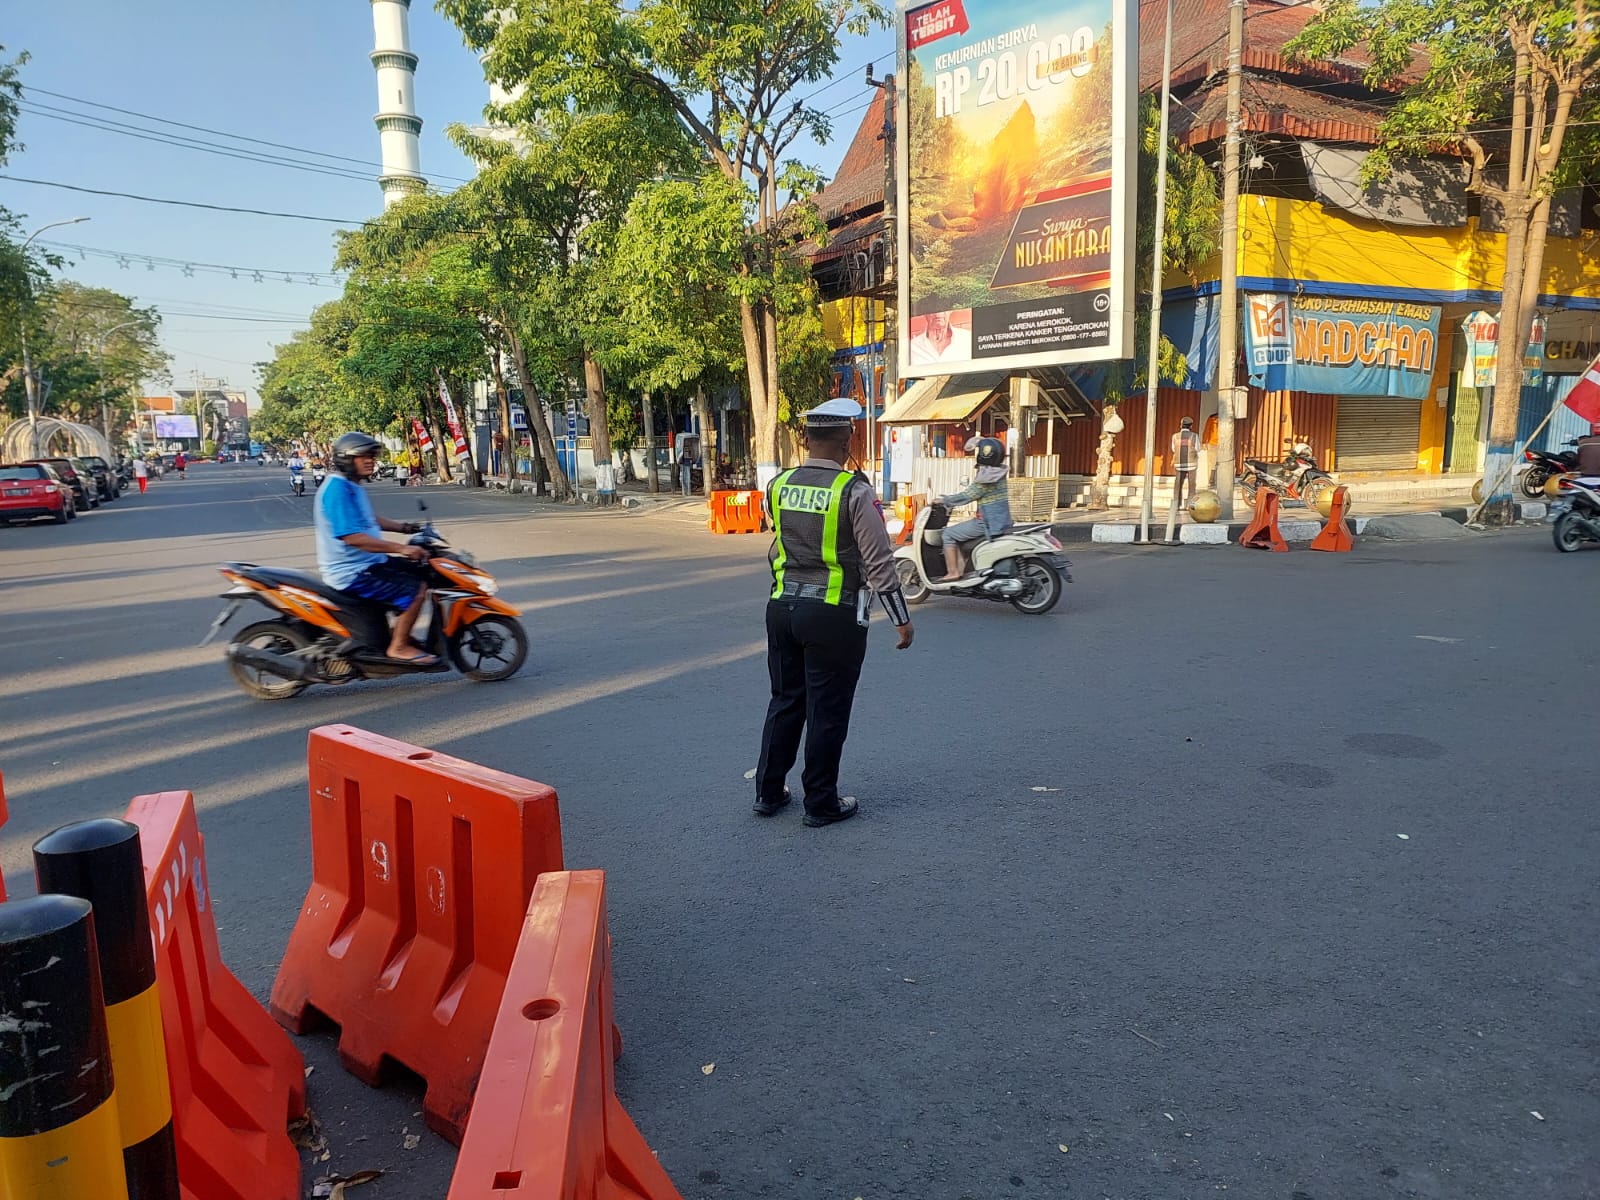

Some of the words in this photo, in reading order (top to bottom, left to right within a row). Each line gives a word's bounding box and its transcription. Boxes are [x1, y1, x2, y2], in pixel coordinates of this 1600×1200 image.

[916, 5, 950, 27] TELAH
[911, 14, 956, 42] TERBIT
[935, 40, 995, 72] KEMURNIAN
[997, 23, 1038, 51] SURYA
[1061, 52, 1087, 69] BATANG
[935, 65, 971, 119] RP
[976, 26, 1094, 107] 20.000
[1041, 217, 1088, 238] Surya
[1016, 225, 1111, 268] NUSANTARA
[1016, 307, 1065, 319] PERINGATAN:
[1292, 296, 1322, 311] TOKO
[1324, 298, 1394, 315] PERHIASAN
[1395, 302, 1432, 321] EMAS
[977, 334, 994, 342] SAYA
[994, 331, 1025, 340] TERKENA
[1025, 327, 1053, 337] KANKER
[1053, 321, 1109, 334] TENGGOROKAN
[1009, 321, 1036, 331] KARENA
[1031, 335, 1060, 345] MEROKOK
[1293, 316, 1434, 371] MADCHAN
[778, 486, 833, 511] POLISI
